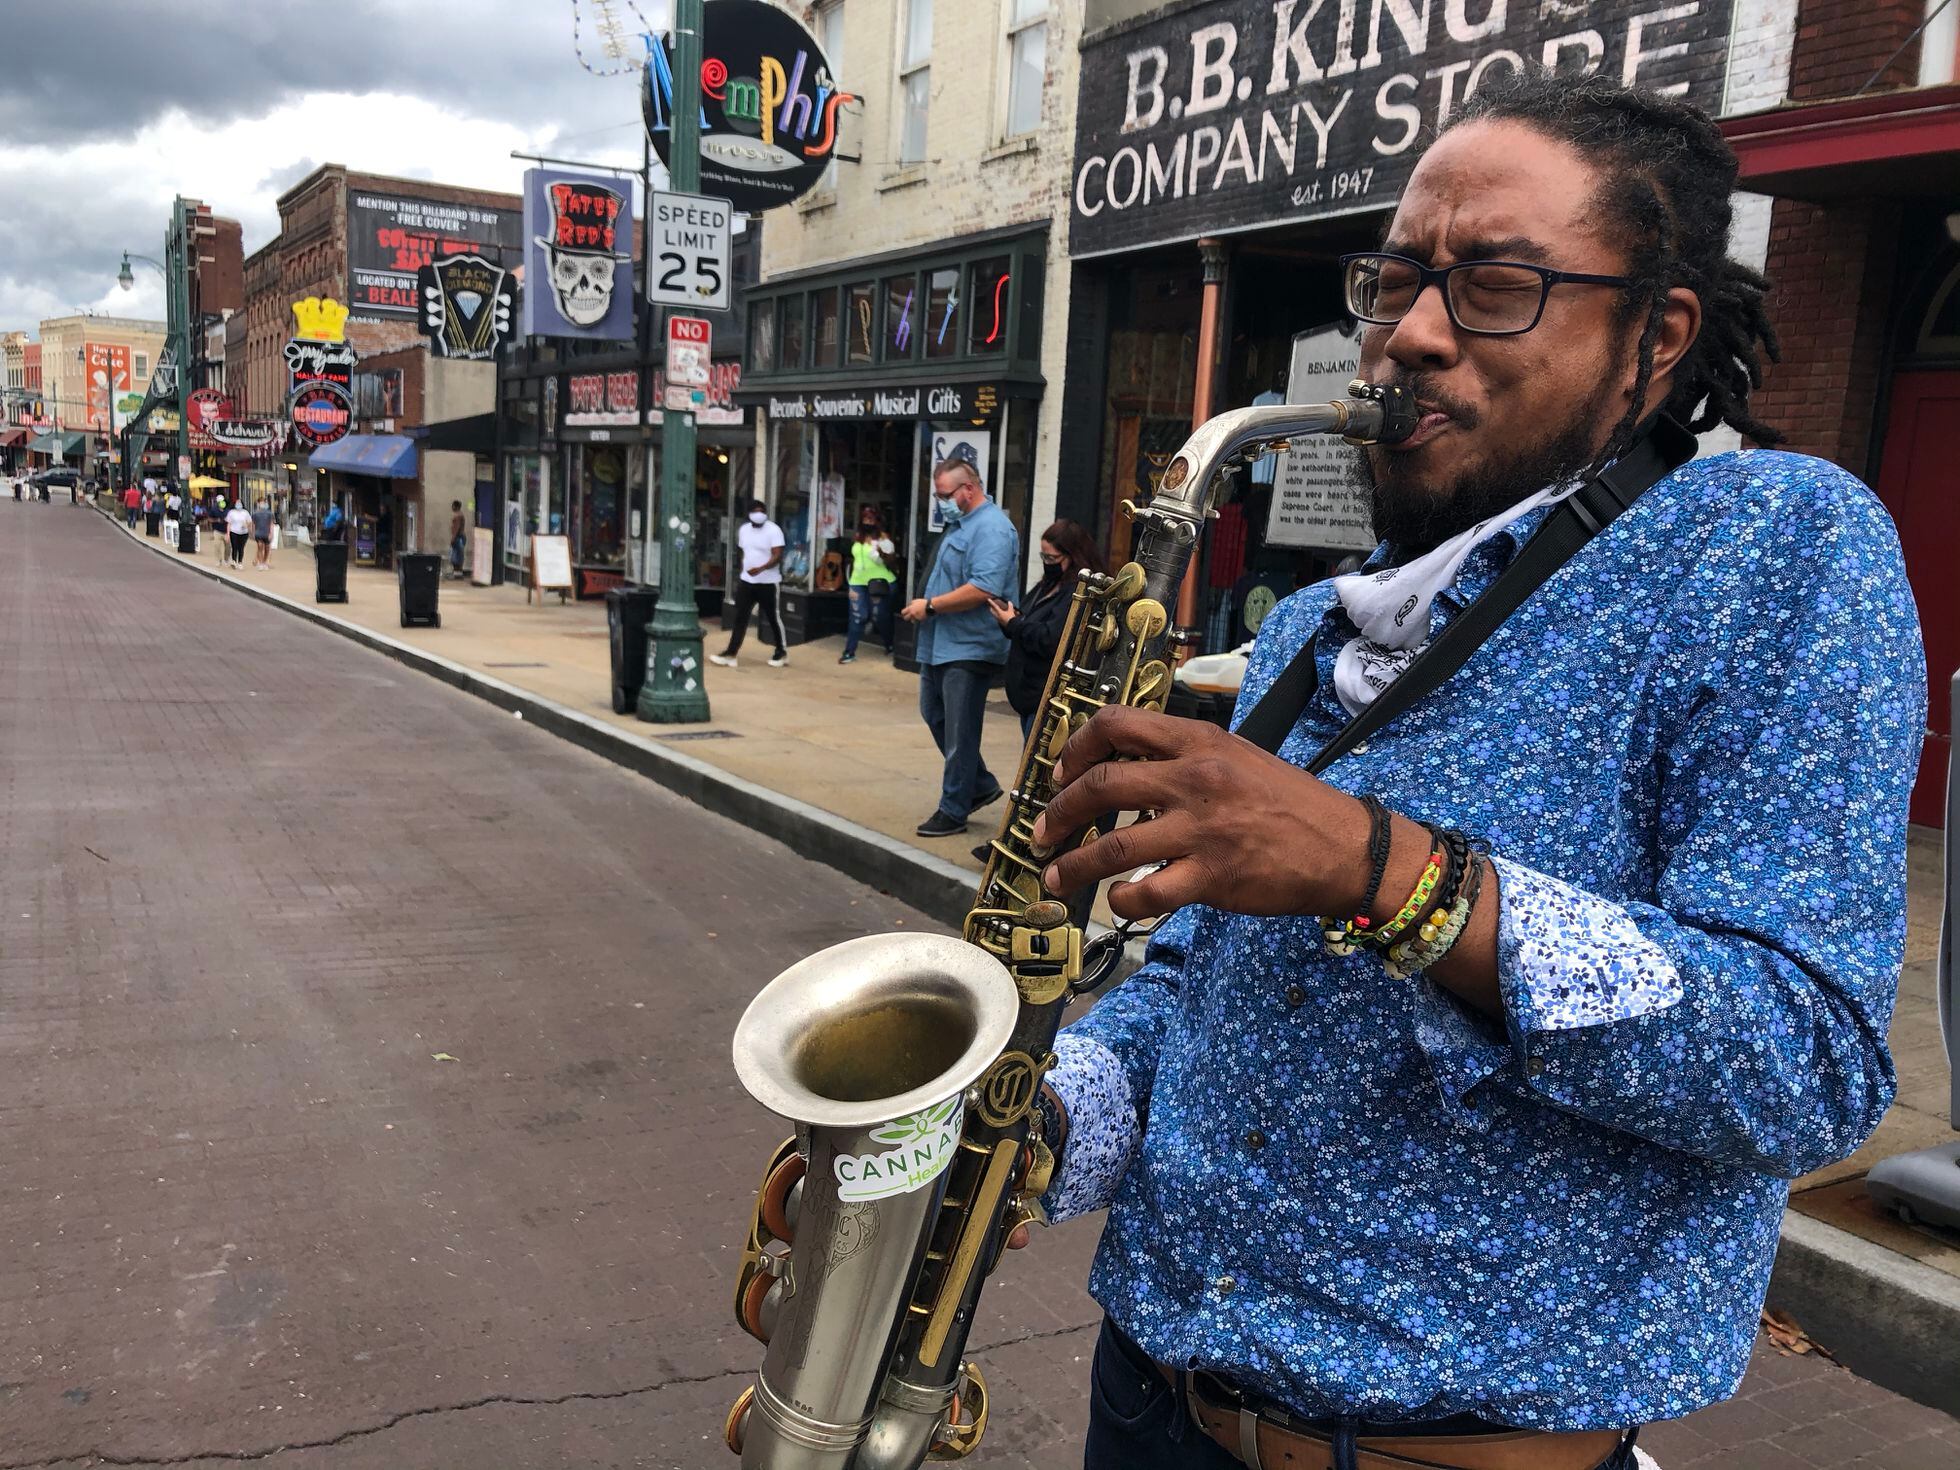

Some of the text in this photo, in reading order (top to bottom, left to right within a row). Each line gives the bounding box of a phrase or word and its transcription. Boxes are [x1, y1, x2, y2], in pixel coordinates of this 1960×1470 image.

[1120, 20, 1253, 135] B.B.
[1076, 88, 1353, 217] COMPANY
[1291, 167, 1374, 206] est. 1947
[357, 197, 499, 225] MENTION THIS BILLBOARD TO GET
[658, 204, 725, 229] SPEED
[397, 214, 460, 232] FREE COVER
[664, 229, 717, 250] LIMIT
[356, 274, 396, 289] LOCATED
[397, 277, 411, 289] ON
[658, 251, 722, 297] 25
[676, 321, 703, 339] NO
[1307, 359, 1358, 375] BENJAMIN
[769, 397, 807, 418] Records
[812, 393, 865, 418] Souvenirs
[874, 388, 920, 415] Musical
[927, 387, 961, 415] Gifts
[293, 406, 349, 424] RESTAURANT
[1287, 463, 1298, 472] law
[1302, 463, 1342, 474] authorizing
[1286, 477, 1303, 485] white
[1327, 490, 1348, 500] heard
[1281, 501, 1311, 512] Supreme
[1313, 502, 1335, 512] Court.
[1341, 504, 1351, 513] At
[1294, 516, 1305, 524] the
[1329, 517, 1365, 529] practicing
